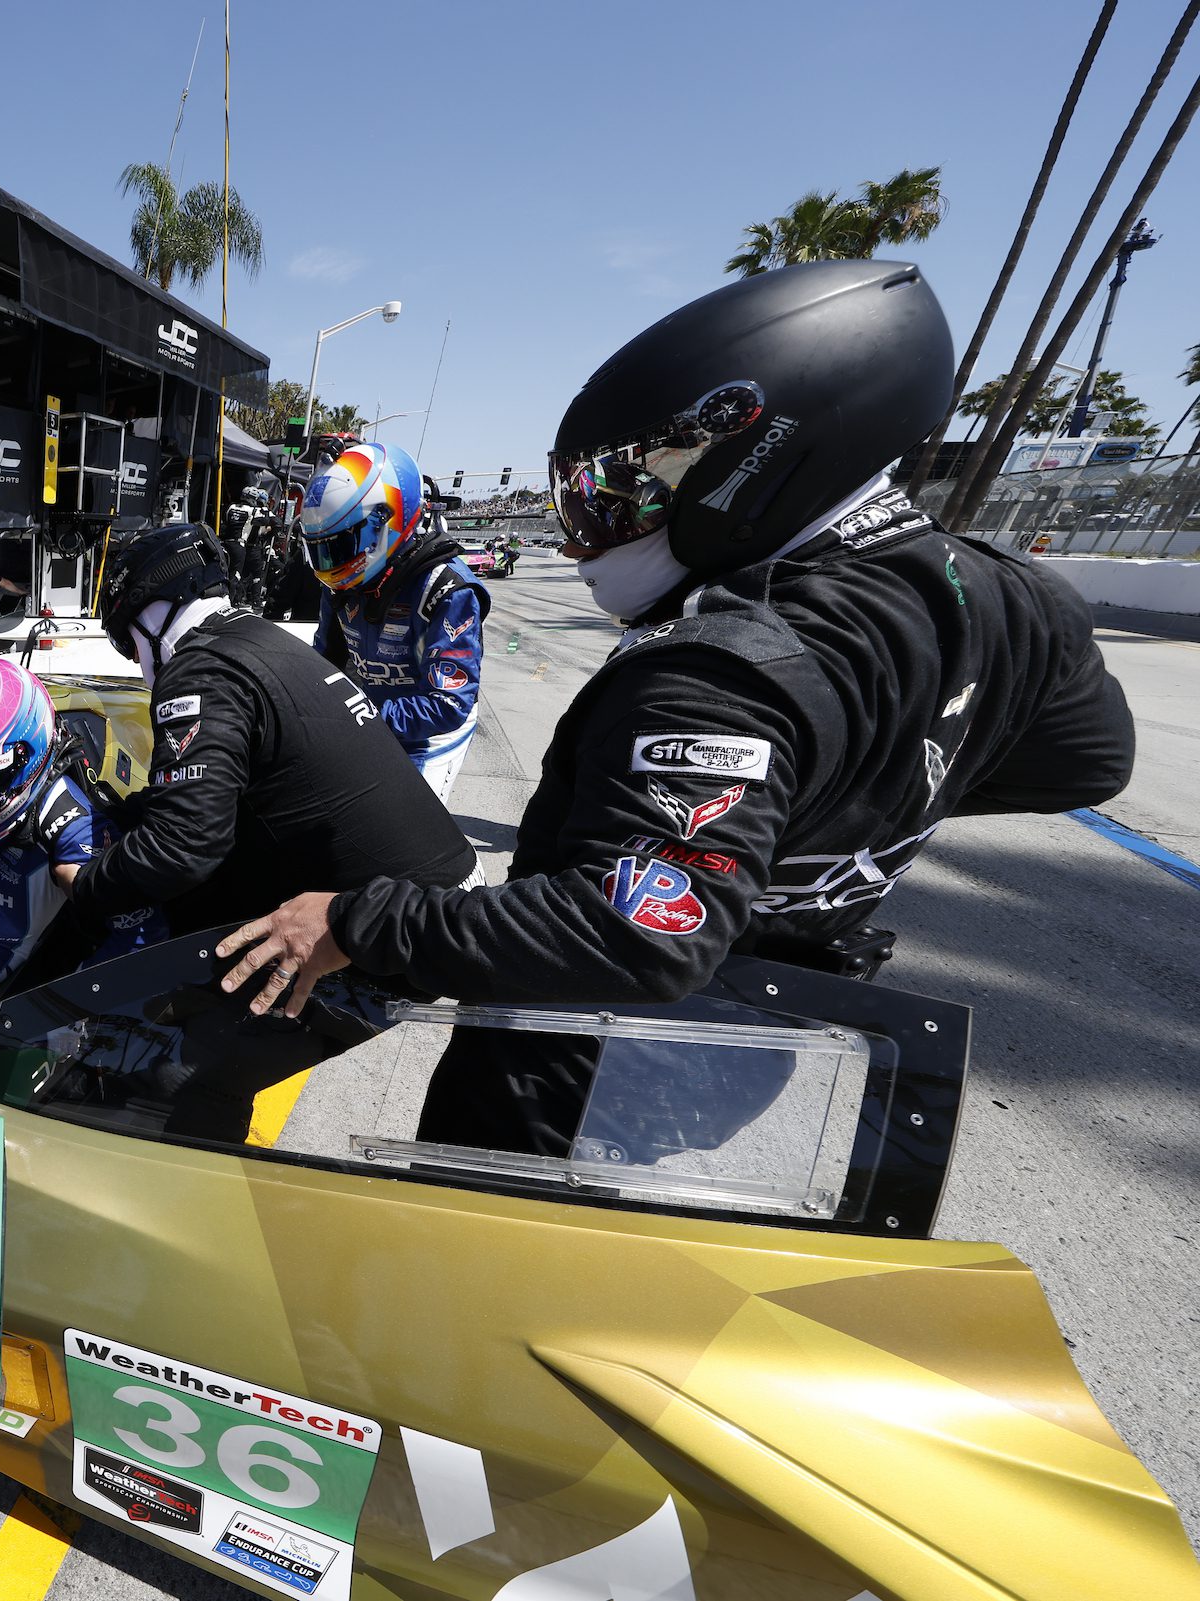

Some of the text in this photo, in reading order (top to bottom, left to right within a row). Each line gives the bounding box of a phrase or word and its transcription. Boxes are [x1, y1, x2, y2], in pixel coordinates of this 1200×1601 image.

[158, 320, 198, 354] JDC
[738, 415, 795, 475] paoli
[776, 420, 800, 449] STOP
[426, 578, 457, 612] HRX
[650, 742, 684, 760] sfi
[692, 744, 755, 756] MANUFACTURER
[702, 752, 743, 763] CERTIFIED
[154, 766, 187, 785] Mobil
[45, 806, 82, 841] HRX
[612, 856, 691, 919] VP
[639, 901, 704, 928] Racing
[112, 1385, 324, 1509] 36
[89, 1462, 197, 1516] WeatherTech
[133, 1470, 166, 1489] IMSA
[228, 1535, 315, 1578] ENDURANCE CUP
[246, 1527, 322, 1569] IMSA MICHELIN
